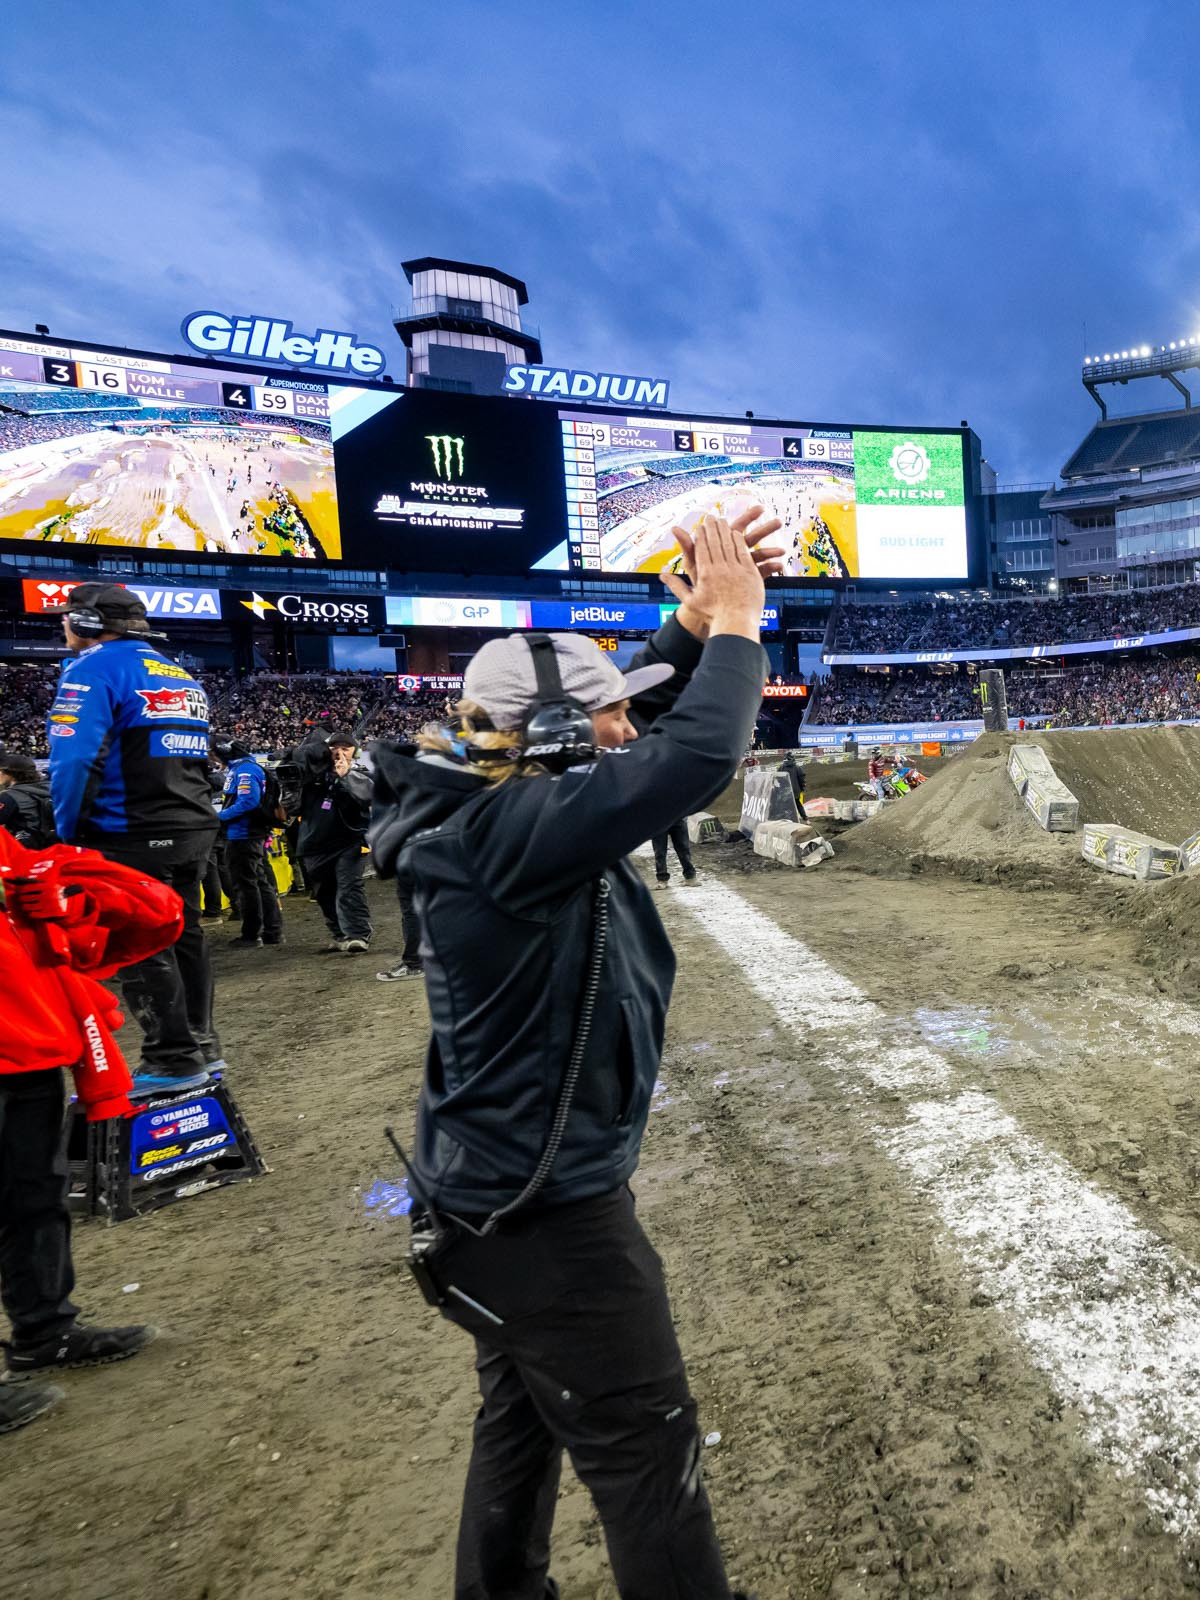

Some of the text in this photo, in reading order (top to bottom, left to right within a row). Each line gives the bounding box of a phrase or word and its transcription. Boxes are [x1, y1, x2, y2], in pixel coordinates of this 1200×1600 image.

[186, 314, 383, 373] Gillette
[96, 355, 149, 368] LAST LAP
[51, 364, 70, 382] 3
[89, 369, 119, 388] 16
[128, 372, 165, 386] TOM
[129, 383, 186, 400] VIALLE
[269, 378, 325, 393] SUPERMOTOCROSS
[505, 367, 668, 404] STADIUM
[229, 389, 246, 405] 4
[262, 393, 287, 409] 59
[578, 425, 589, 433] 37
[611, 427, 641, 438] COTY
[579, 438, 591, 446] 69
[611, 437, 657, 448] SCHOCK
[678, 435, 690, 449] 3
[702, 437, 719, 450] 16
[725, 436, 747, 445] TOM
[725, 444, 760, 455] VIALLE
[787, 442, 798, 455] 4
[808, 444, 825, 456] 59
[581, 452, 591, 460] 16
[581, 465, 592, 473] 59
[410, 482, 488, 498] MONSTER
[874, 488, 946, 499] ARIENS
[382, 494, 400, 502] AMA
[424, 494, 477, 503] ENERGY
[374, 500, 525, 522] SUPERCROSS
[409, 516, 494, 530] CHAMPIONSHIP
[584, 519, 596, 527] 75
[880, 536, 945, 548] BUD LIGHT
[571, 545, 581, 553] 10
[573, 559, 581, 567] 11
[130, 590, 219, 615] VISA
[277, 595, 369, 619] CROSS
[283, 616, 369, 624] INSURANCE
[570, 607, 625, 624] jetBlue
[1113, 639, 1129, 648] LAST
[916, 653, 954, 662] LAST LAP
[523, 743, 564, 757] FXR
[149, 839, 173, 847] FXR
[83, 1013, 110, 1073] HONDA
[162, 1104, 203, 1122] YAMAHA
[178, 1112, 209, 1127] GIZMO
[180, 1120, 209, 1134] MODS
[185, 1133, 228, 1154] FXR
[143, 1148, 227, 1181] Polisport
